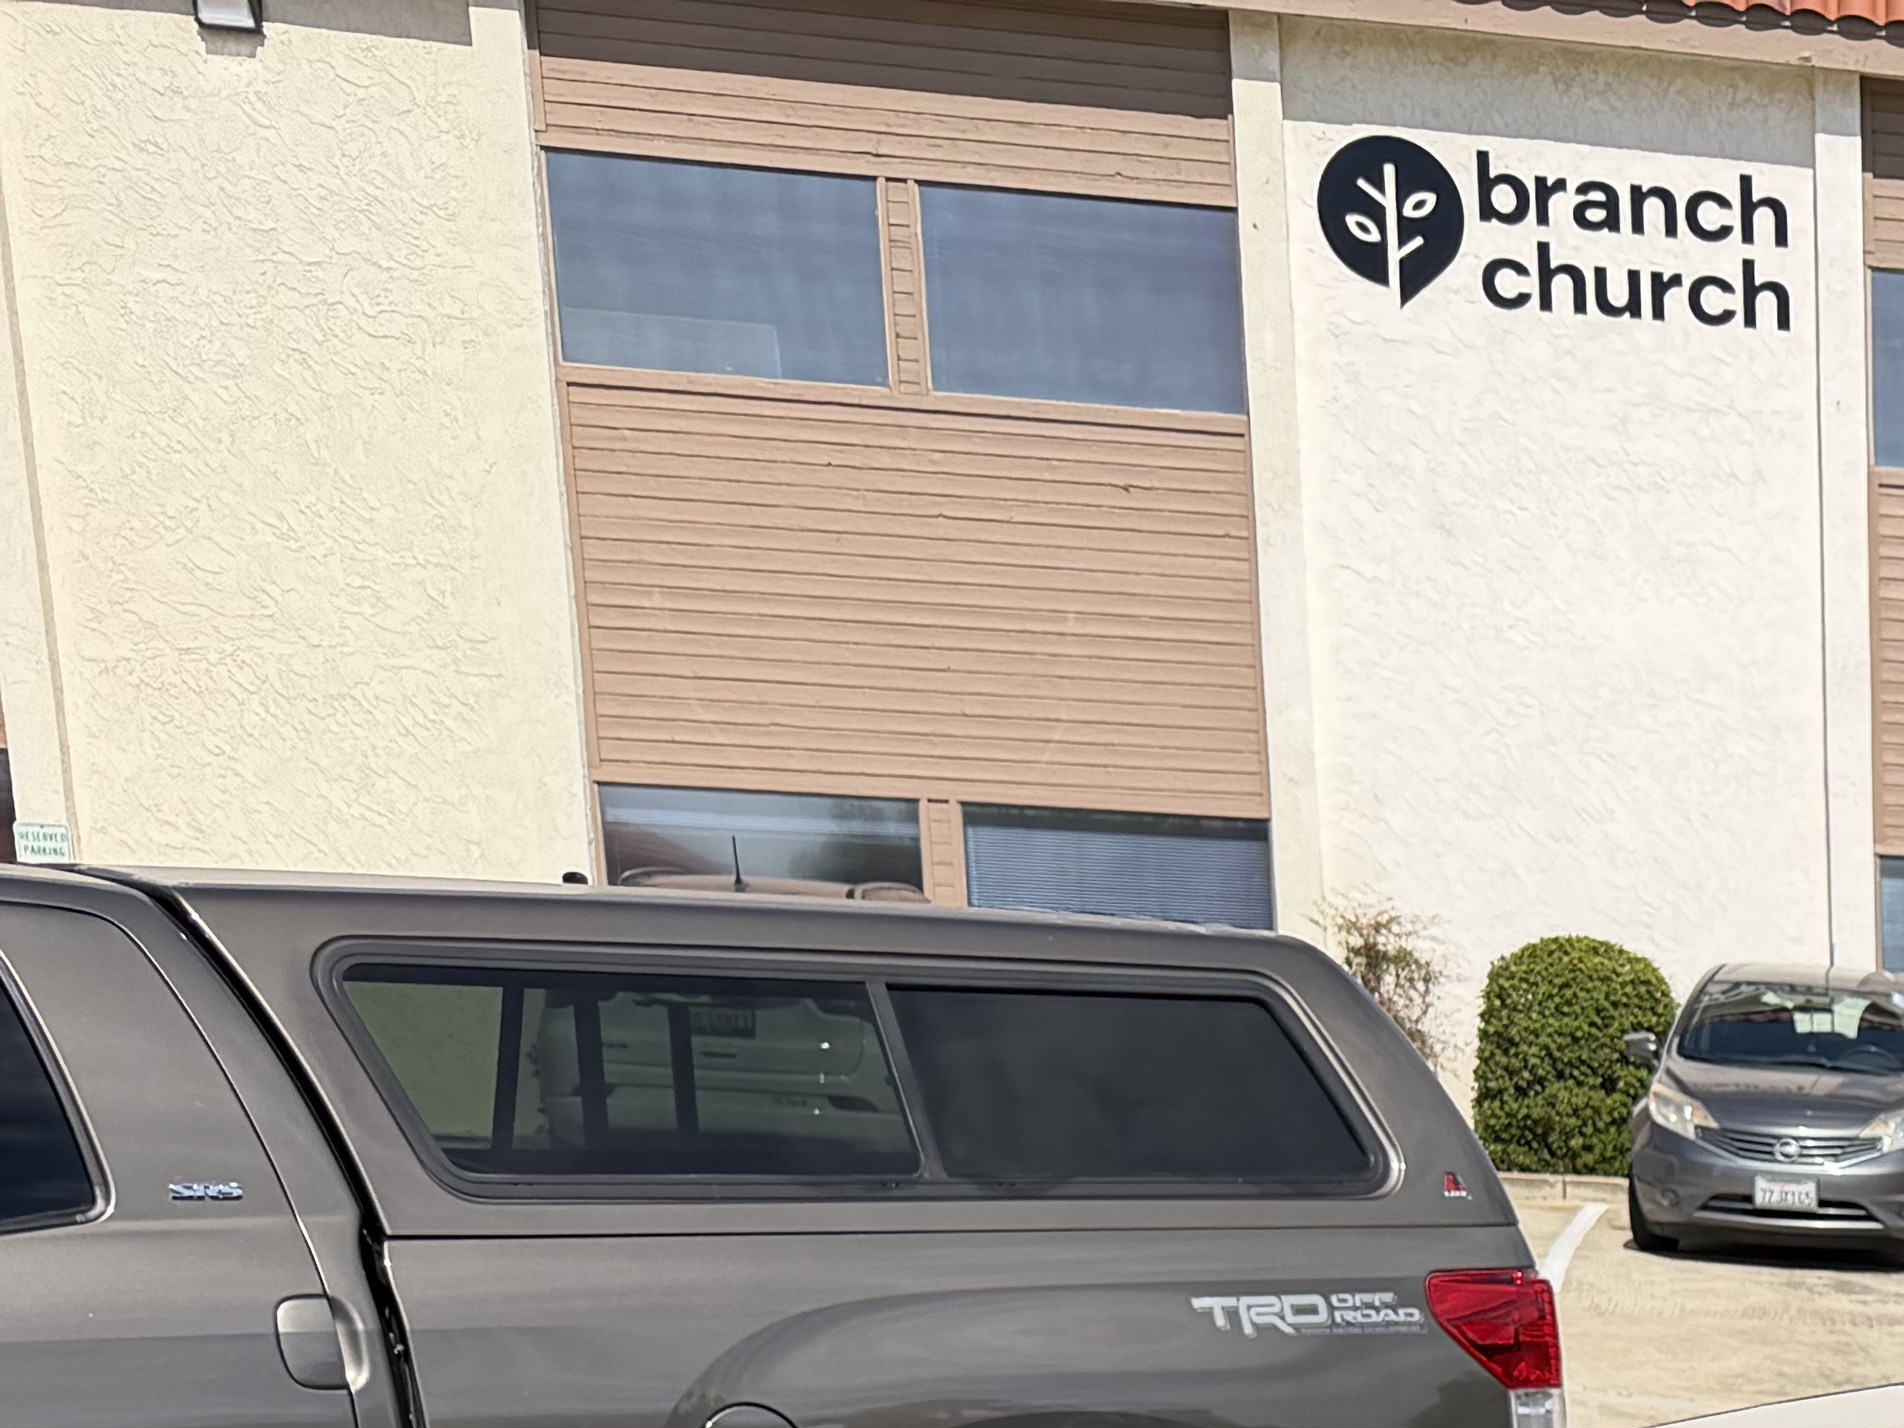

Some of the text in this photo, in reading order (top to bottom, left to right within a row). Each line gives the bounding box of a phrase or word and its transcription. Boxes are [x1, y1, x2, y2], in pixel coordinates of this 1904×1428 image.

[1476, 149, 1789, 249] branch
[1481, 241, 1791, 332] church
[19, 831, 67, 843] RESERVED
[23, 845, 66, 857] PARKING
[1330, 1292, 1398, 1309] OFF
[1190, 1293, 1332, 1339] TRD
[1334, 1307, 1425, 1325] ROAD
